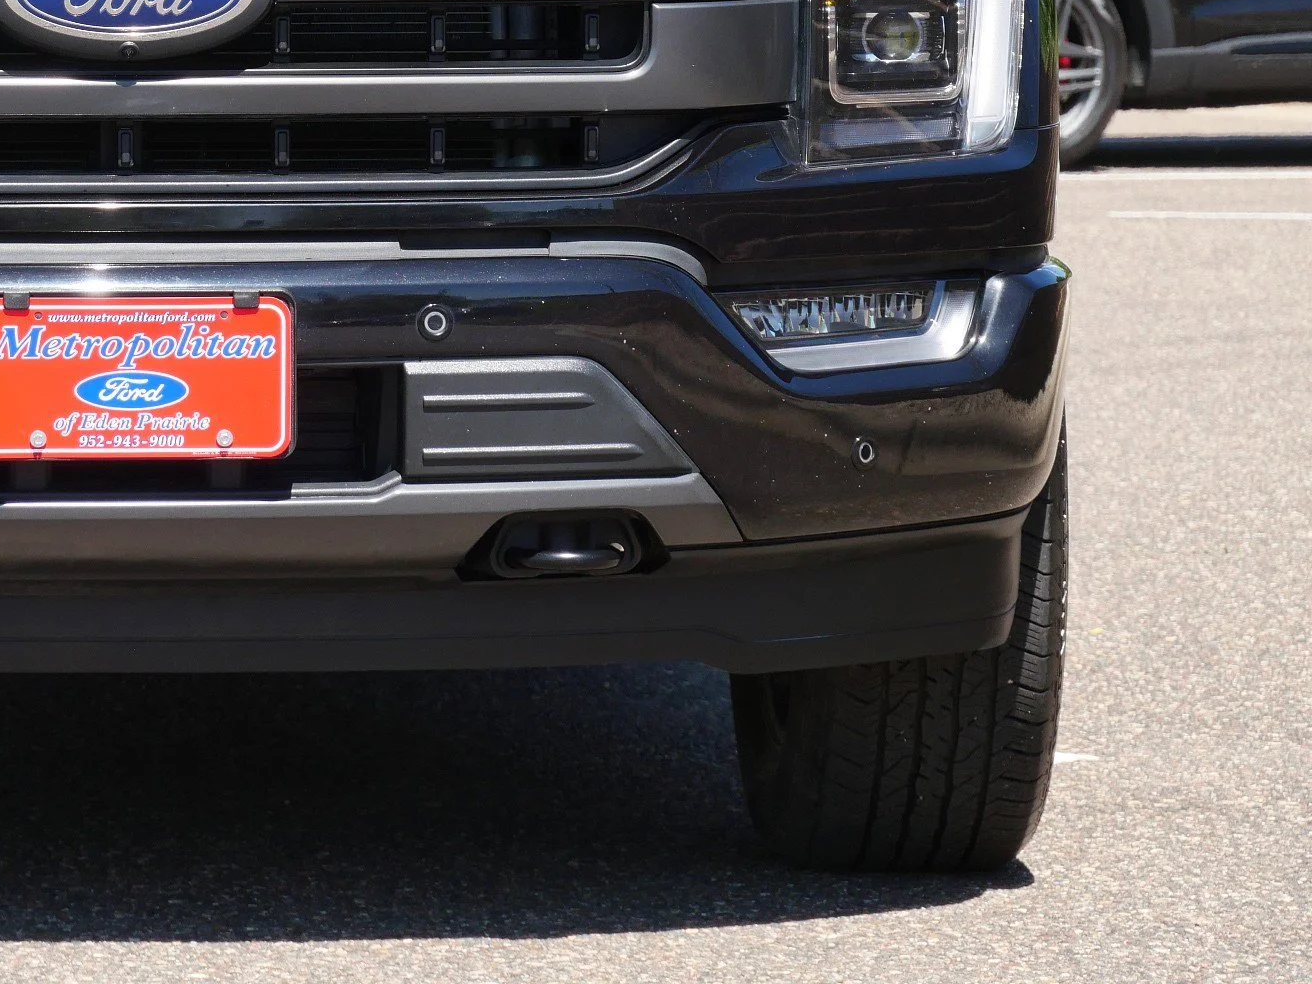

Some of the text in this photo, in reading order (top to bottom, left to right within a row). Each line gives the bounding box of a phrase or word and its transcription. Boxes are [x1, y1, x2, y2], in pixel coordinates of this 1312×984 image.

[48, 312, 216, 325] www.metropolitanford.com
[98, 377, 165, 402] Ford
[54, 412, 211, 436] of Eden Prairie
[79, 434, 185, 447] 952-943-9000
